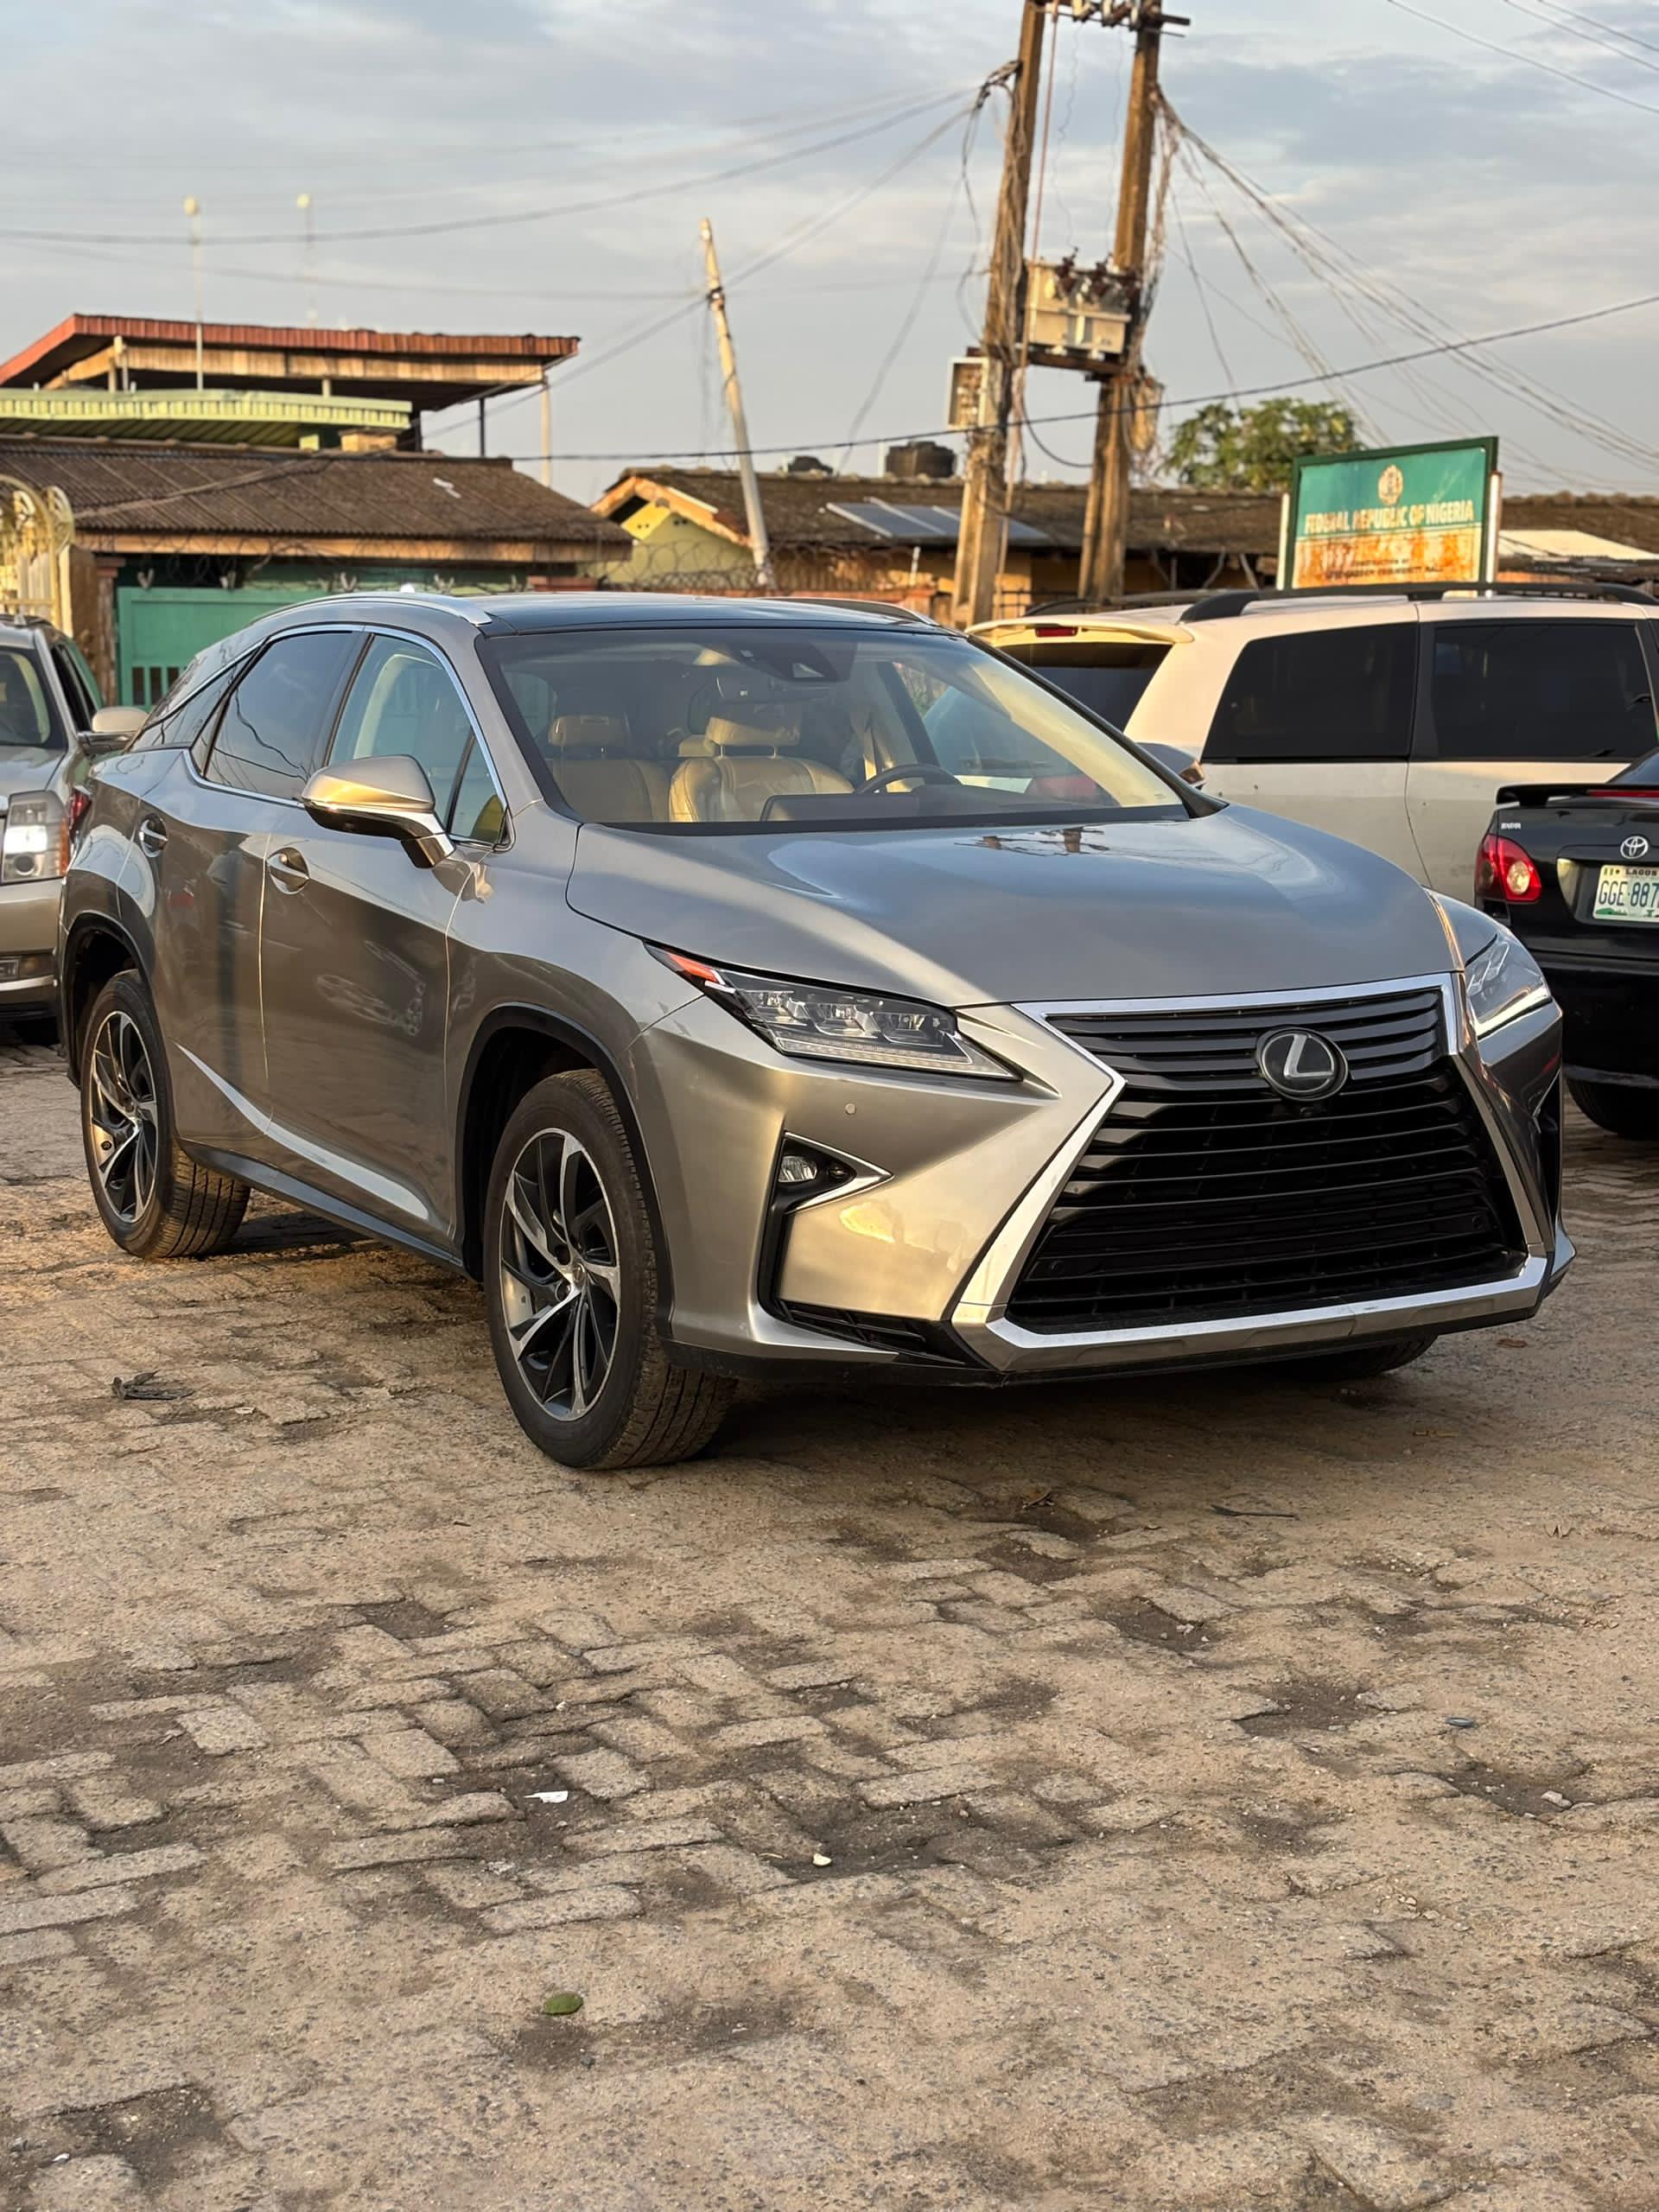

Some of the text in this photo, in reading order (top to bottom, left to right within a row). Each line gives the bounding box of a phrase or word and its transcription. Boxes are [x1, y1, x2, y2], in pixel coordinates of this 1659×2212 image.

[1306, 500, 1473, 533] FEDERAL REPUBLIC OF NIGERIA
